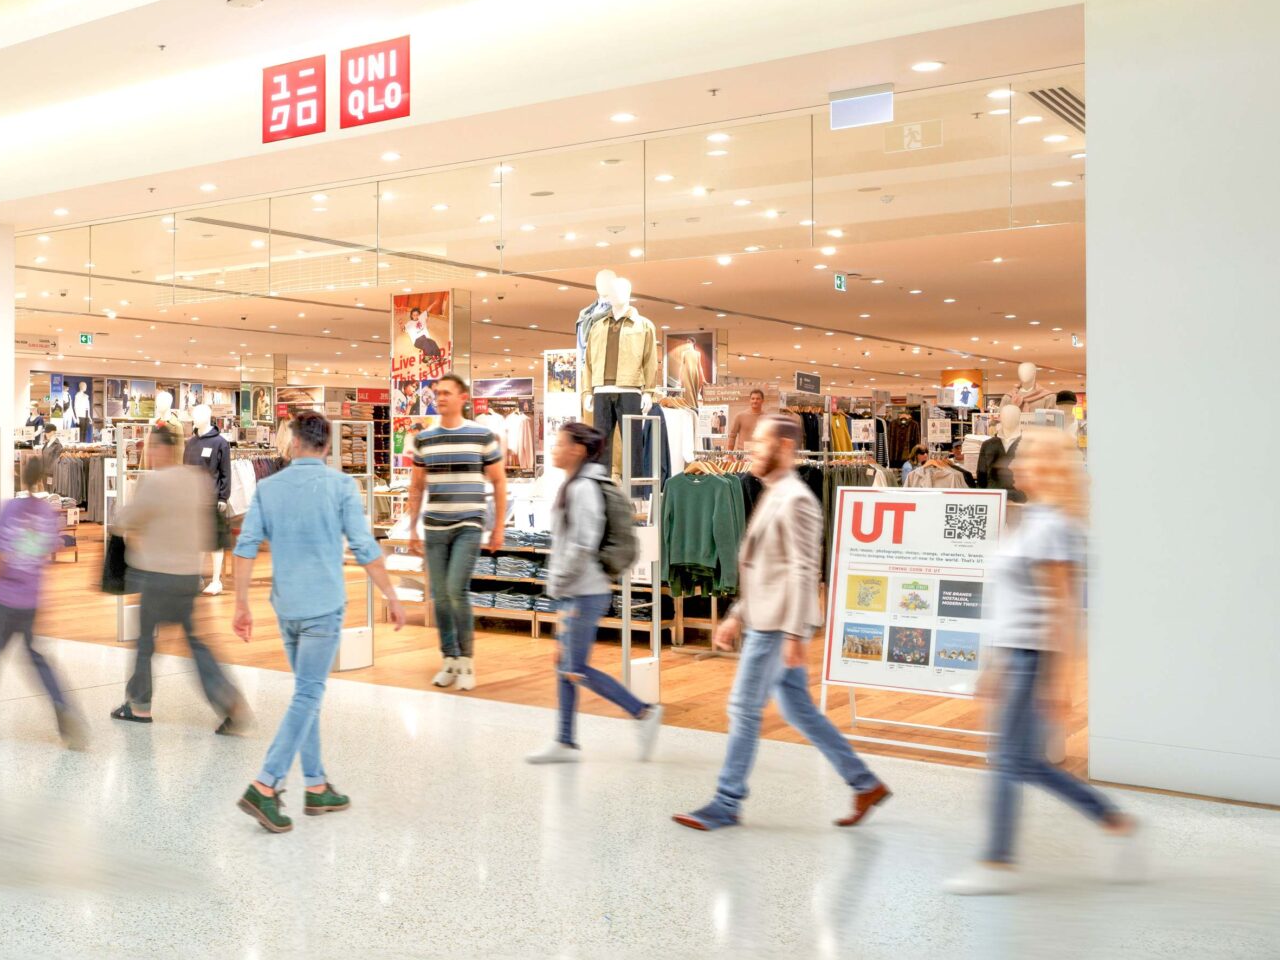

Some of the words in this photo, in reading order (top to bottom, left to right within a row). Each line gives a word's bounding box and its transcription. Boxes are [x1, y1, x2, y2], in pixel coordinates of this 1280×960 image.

[270, 67, 317, 102] ユニ
[348, 49, 397, 85] UNI
[348, 82, 402, 120] QLO
[391, 371, 417, 389] This
[419, 368, 428, 382] is
[392, 355, 416, 372] Live
[851, 501, 917, 544] UT
